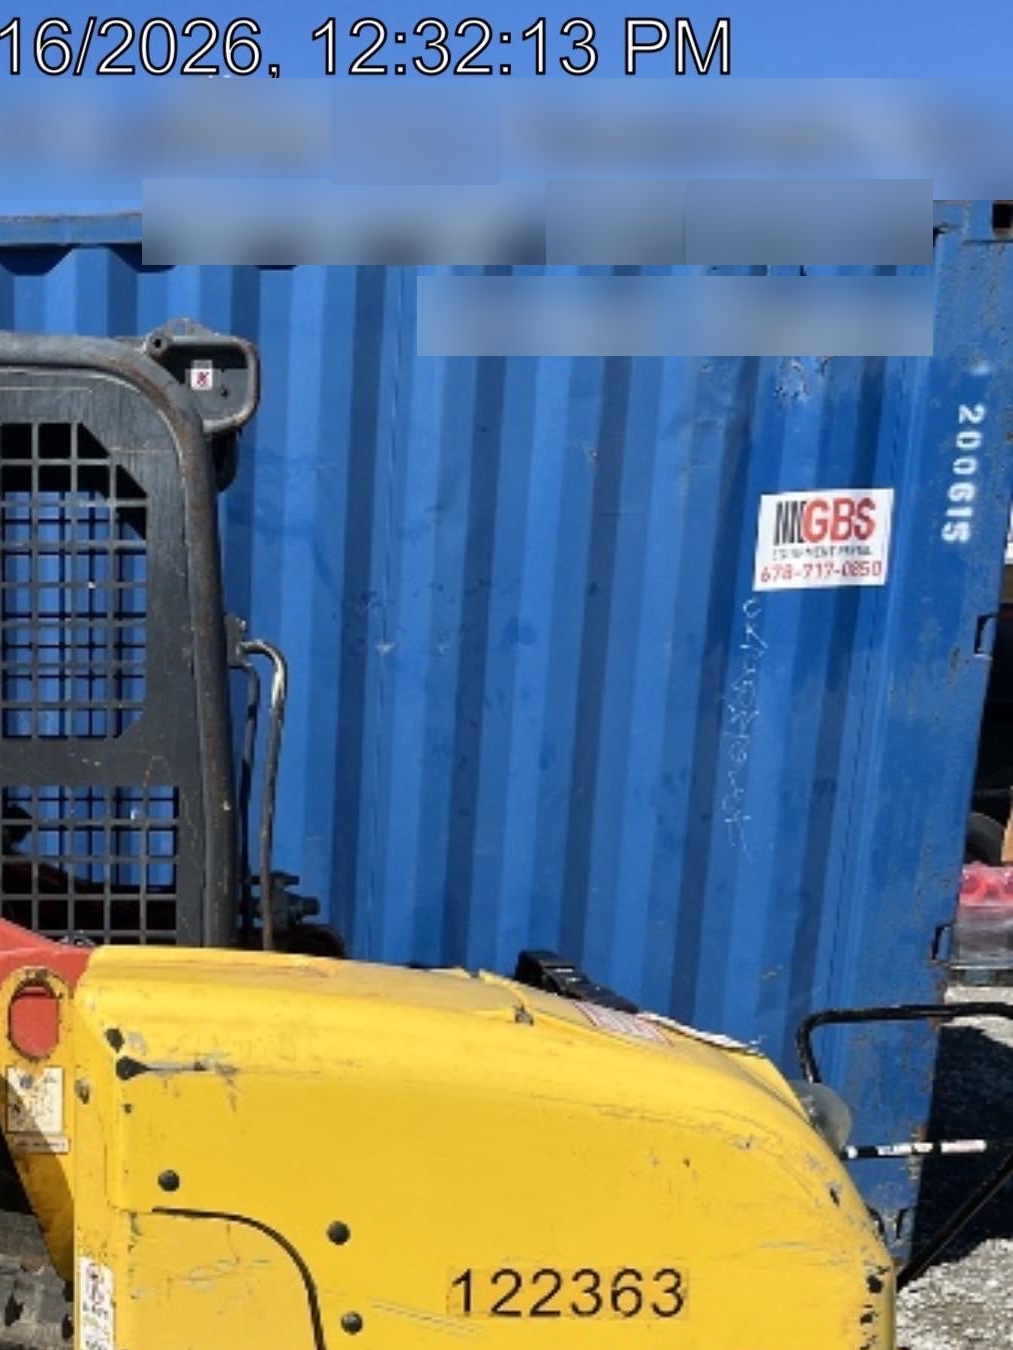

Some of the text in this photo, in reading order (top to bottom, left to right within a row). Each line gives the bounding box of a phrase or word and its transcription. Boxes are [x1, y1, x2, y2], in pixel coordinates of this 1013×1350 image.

[803, 497, 877, 543] GBS
[760, 560, 883, 583] 678-717-0850
[451, 1267, 685, 1318] 122363
